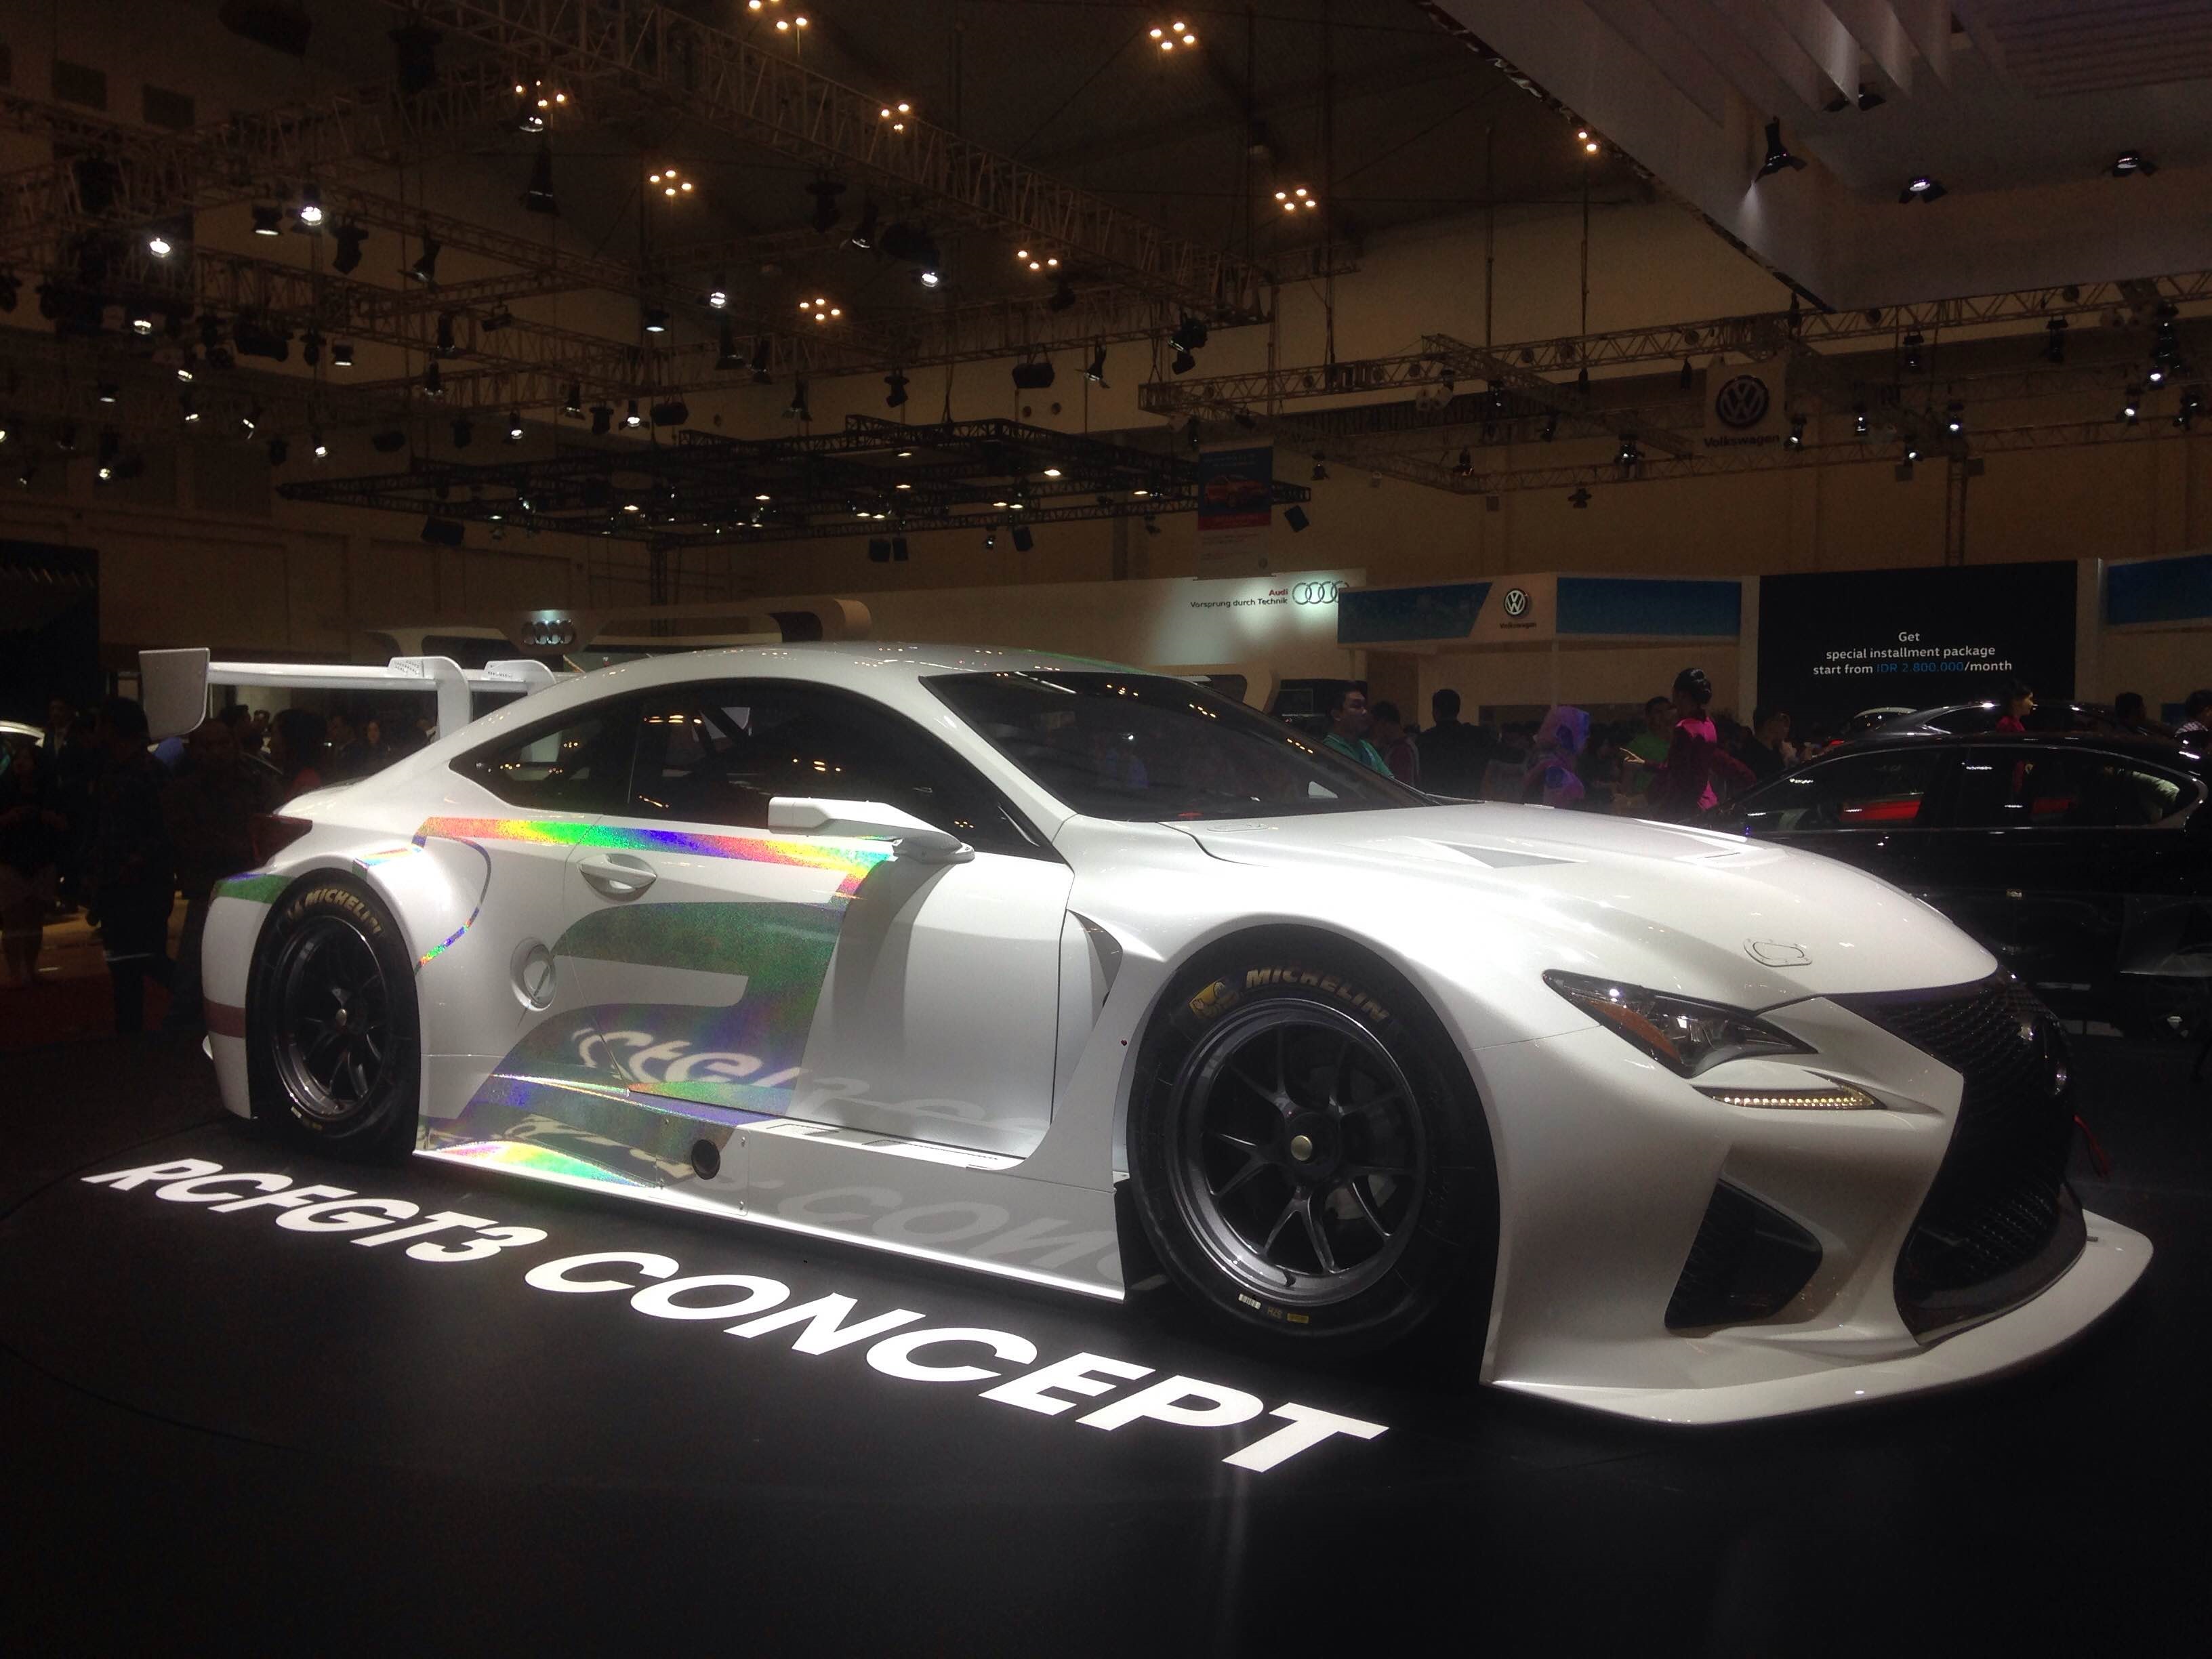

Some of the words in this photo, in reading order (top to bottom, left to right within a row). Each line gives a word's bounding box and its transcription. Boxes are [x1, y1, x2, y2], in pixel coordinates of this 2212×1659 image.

[1704, 435, 1780, 447] Volkswagen
[1268, 588, 1289, 596] Audi
[1258, 597, 1288, 605] Technik
[1898, 632, 1921, 642] Get
[1826, 649, 1868, 661] special
[1869, 647, 1941, 659] installment
[1943, 644, 1996, 659] package
[1813, 664, 1842, 675] start
[1844, 663, 1874, 674] from
[1877, 662, 1898, 673] IDR
[304, 888, 383, 934] MICHELIN
[1246, 967, 1391, 1023] MICHELIN
[525, 1252, 1389, 1473] CONCEPT
